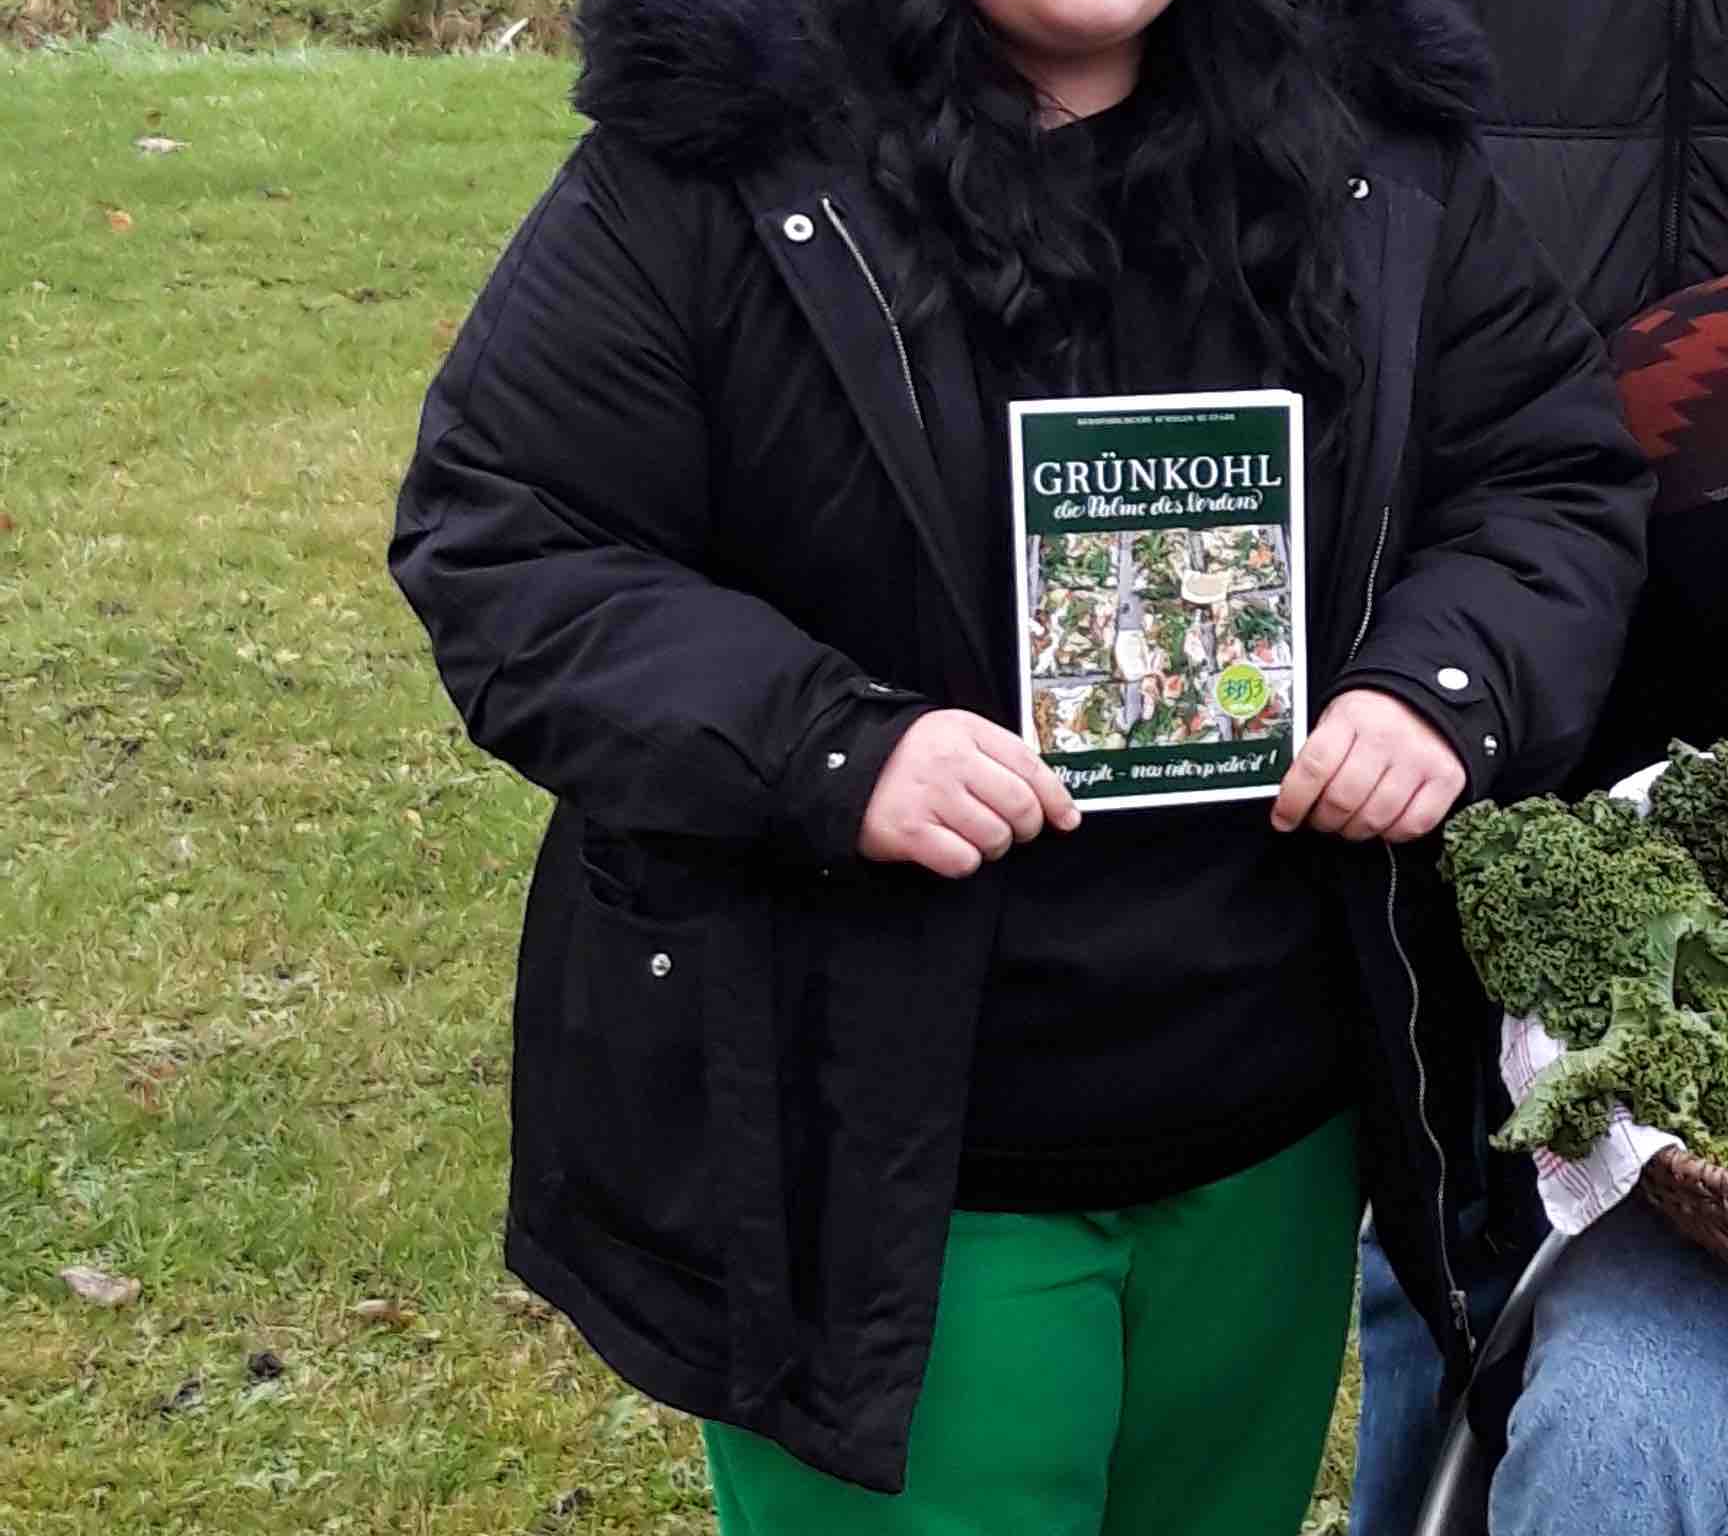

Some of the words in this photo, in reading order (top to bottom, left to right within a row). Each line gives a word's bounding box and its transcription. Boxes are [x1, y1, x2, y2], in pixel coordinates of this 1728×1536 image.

[1033, 450, 1282, 496] GRÜNKOHL
[1053, 499, 1086, 520] die
[1150, 496, 1184, 516] des
